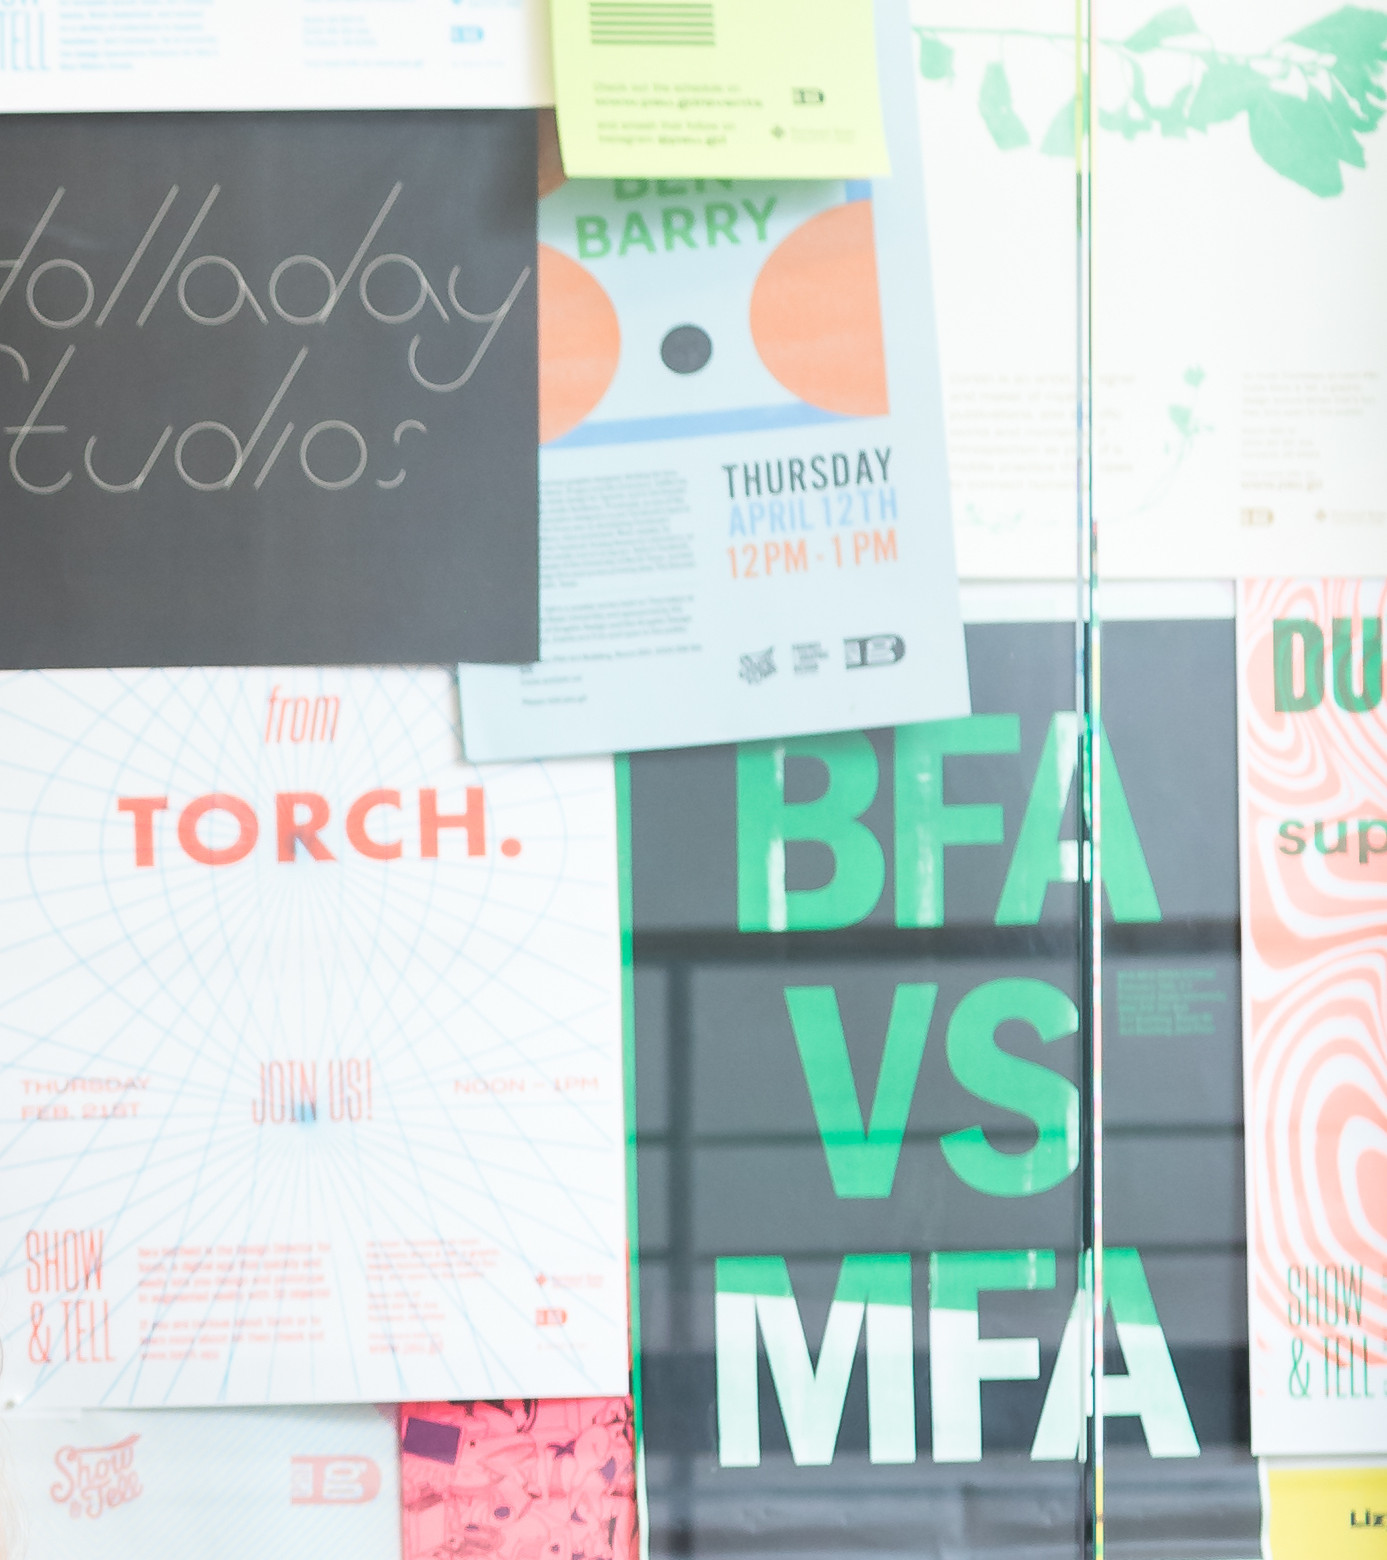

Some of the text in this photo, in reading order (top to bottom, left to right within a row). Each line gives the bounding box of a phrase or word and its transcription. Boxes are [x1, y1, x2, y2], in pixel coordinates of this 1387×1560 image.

[576, 196, 778, 261] BARRY
[722, 446, 893, 501] THURSDAY
[728, 486, 898, 538] APRIL 12TH
[118, 786, 524, 869] TORCH.
[736, 709, 1162, 936] BFA
[252, 1058, 374, 1125] JOIN US!
[782, 975, 1079, 1200] VS
[715, 1248, 1201, 1469] MFA
